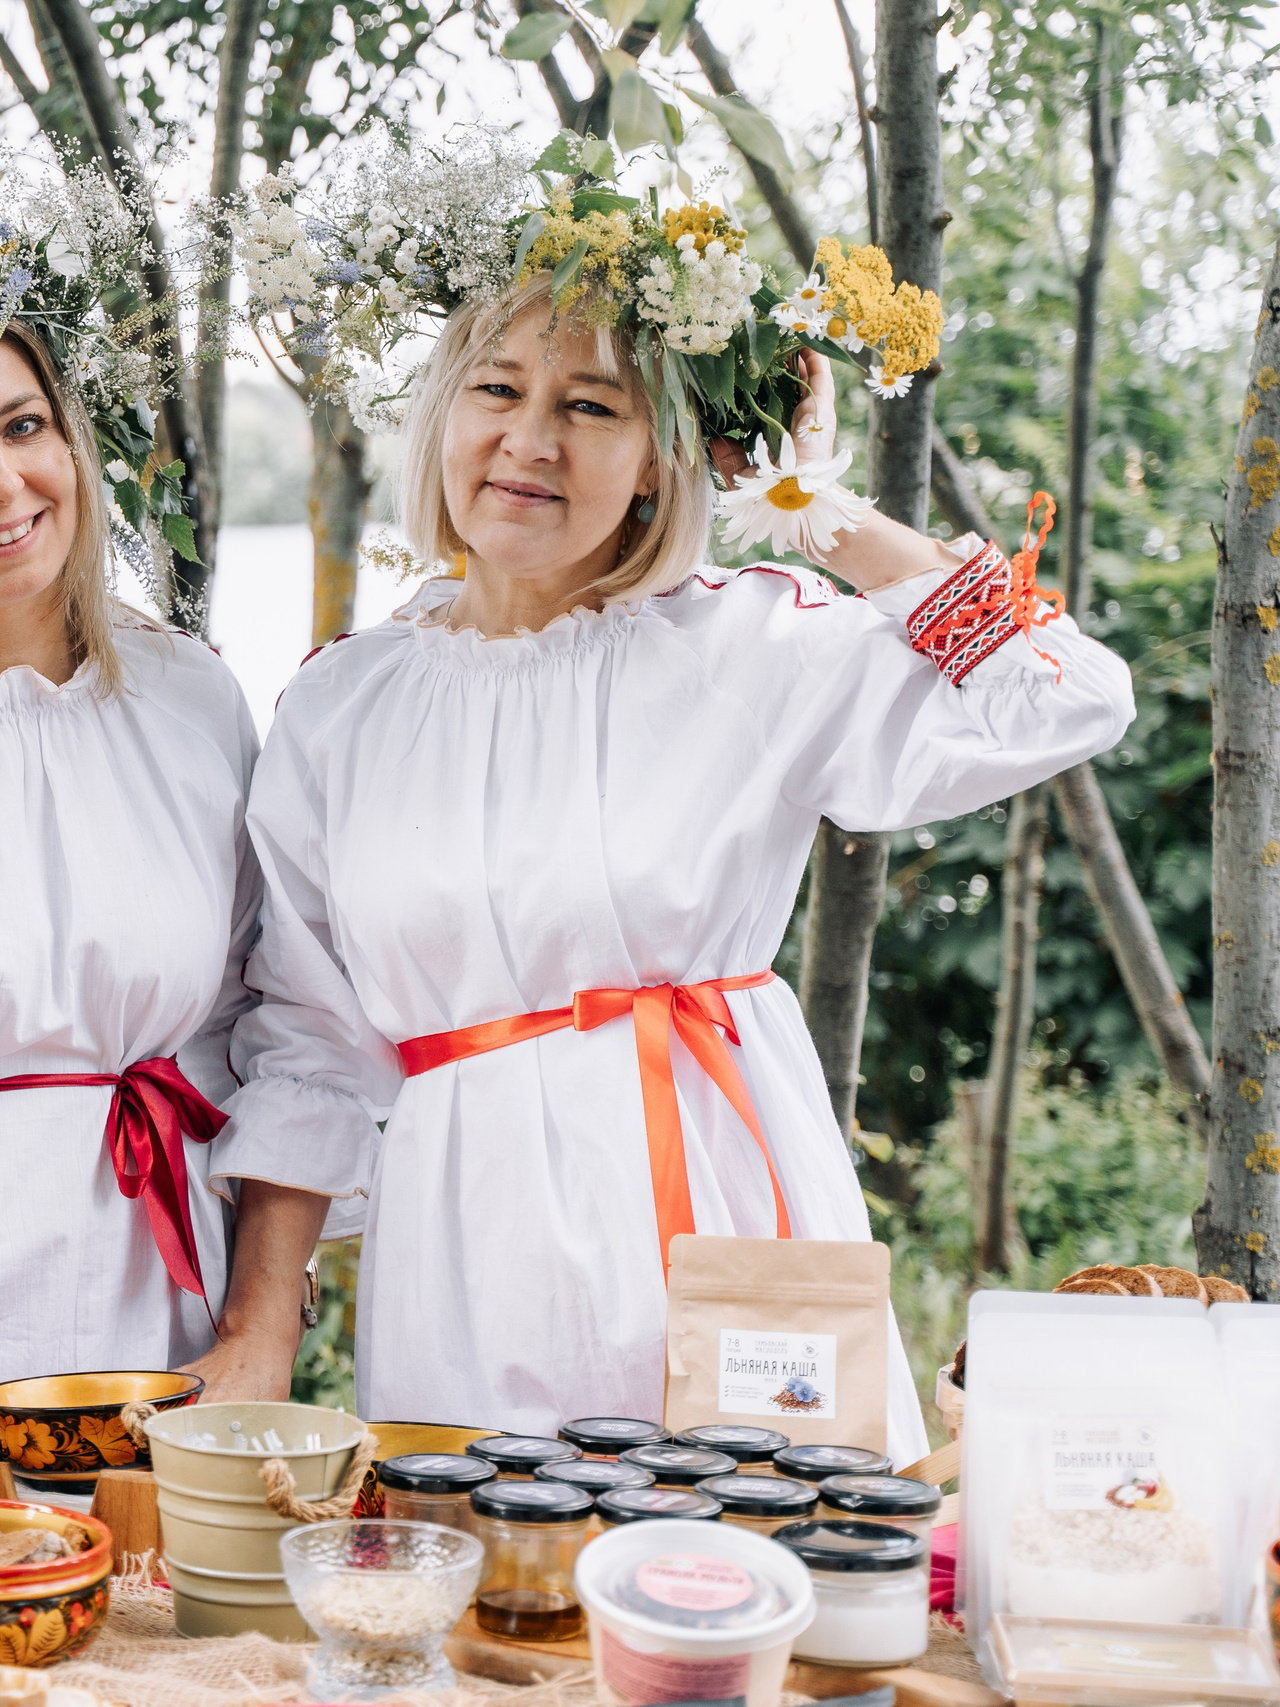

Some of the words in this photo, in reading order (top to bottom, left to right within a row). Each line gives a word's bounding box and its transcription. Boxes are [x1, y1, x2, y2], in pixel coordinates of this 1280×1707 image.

[727, 1338, 740, 1347] 7-8
[726, 1358, 777, 1375] ЛЬНЯНАЯ
[782, 1362, 817, 1377] КАША
